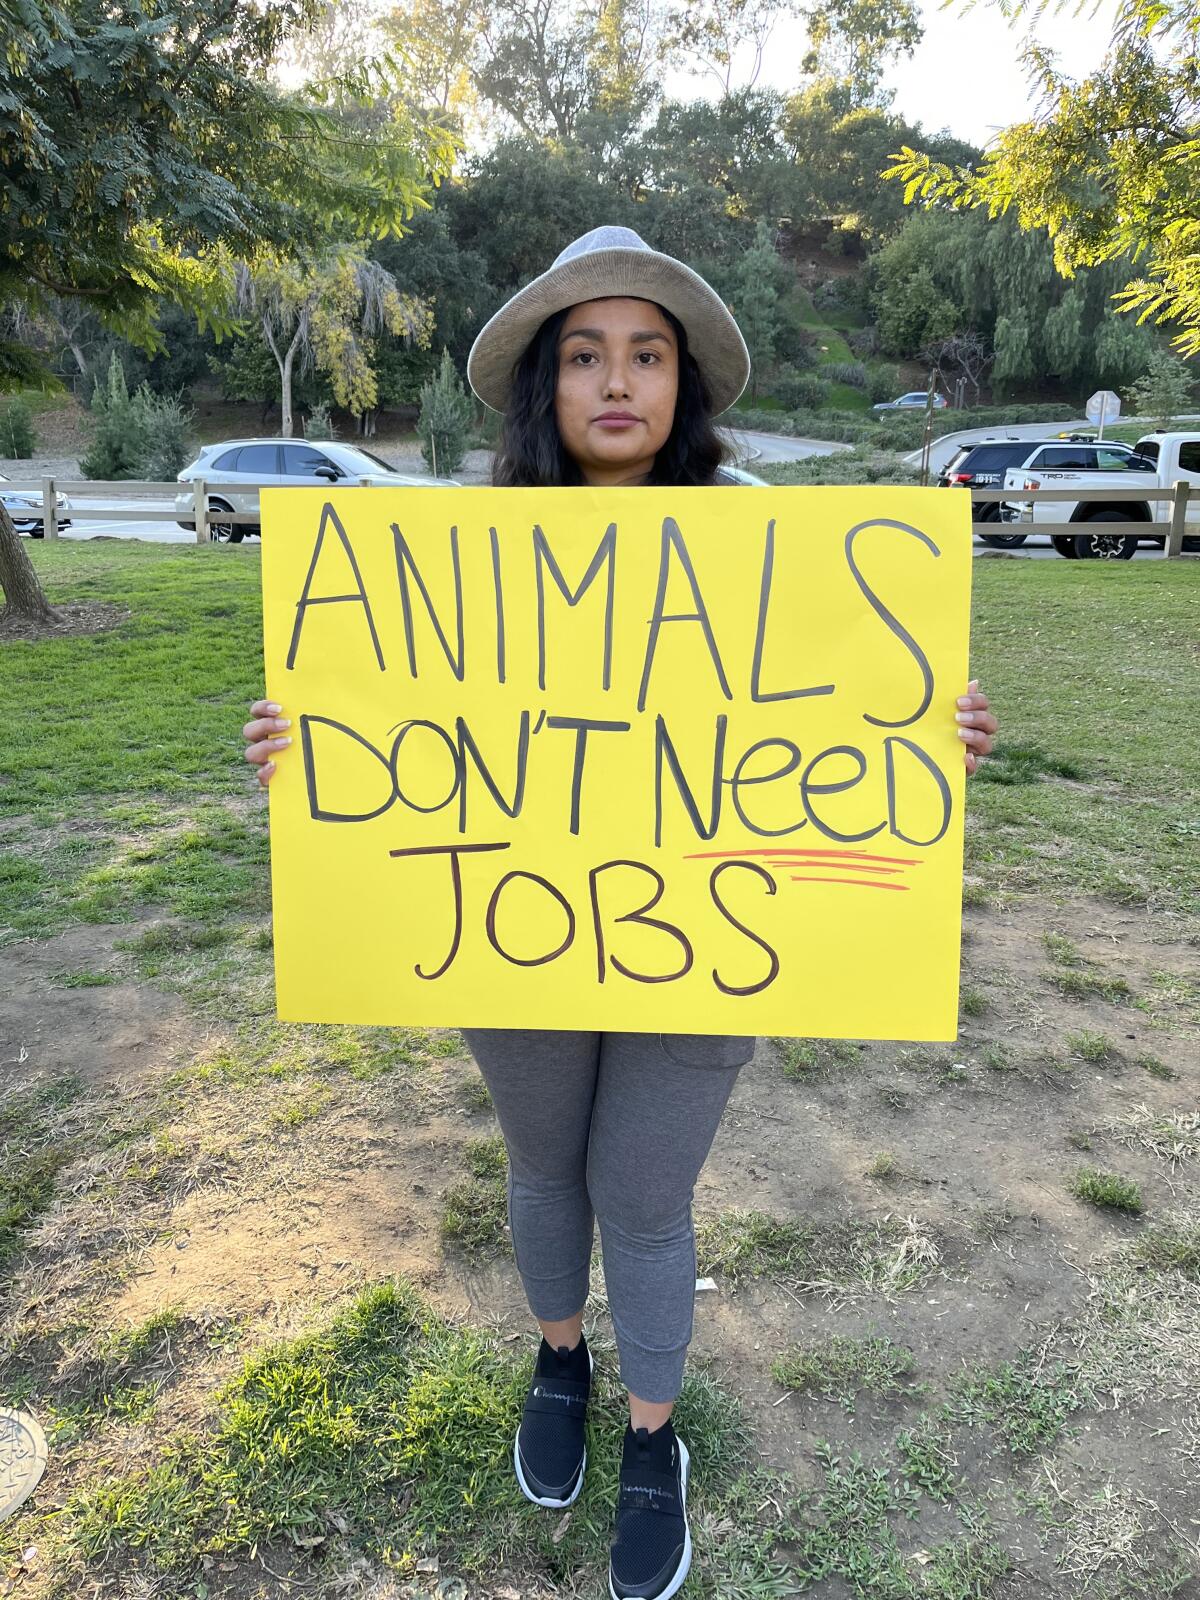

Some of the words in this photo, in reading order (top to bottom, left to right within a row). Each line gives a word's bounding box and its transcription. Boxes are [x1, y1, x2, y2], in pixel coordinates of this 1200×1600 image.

[286, 502, 941, 728] ANIMALS
[300, 709, 631, 836] DON'T
[389, 842, 779, 996] JOBS
